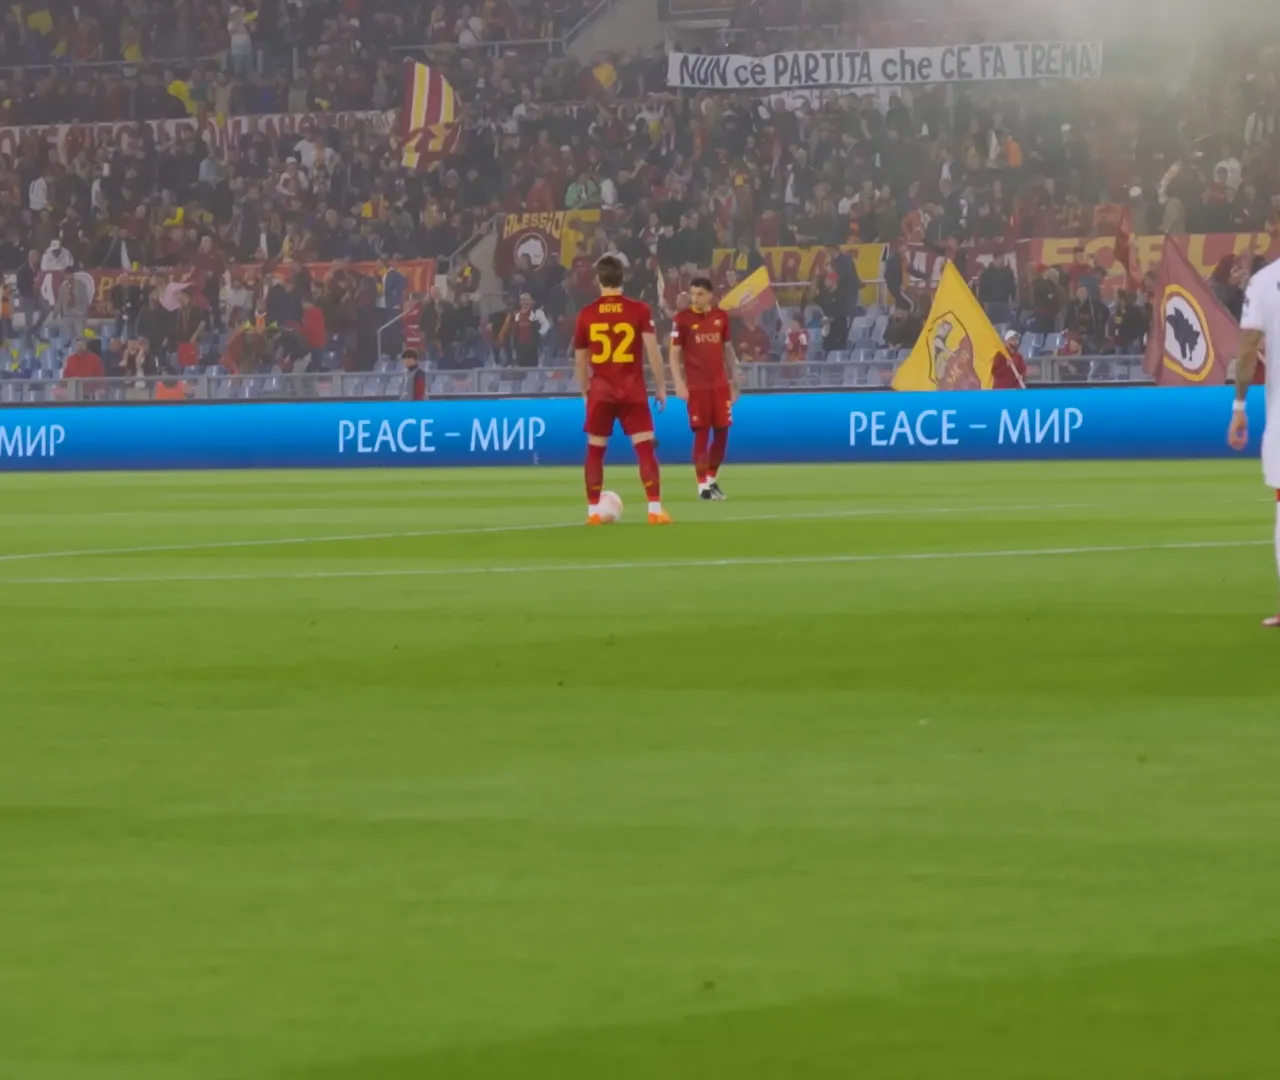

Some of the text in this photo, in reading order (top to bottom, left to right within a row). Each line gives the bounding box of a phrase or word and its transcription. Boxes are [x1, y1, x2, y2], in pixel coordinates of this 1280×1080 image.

[679, 54, 730, 87] NUN
[773, 51, 873, 85] PARTITA
[881, 48, 933, 82] che
[940, 46, 974, 80] CE
[979, 45, 1007, 78] FA
[598, 302, 623, 314] BOVE
[589, 322, 636, 364] 52
[338, 418, 437, 453] PEACE
[469, 415, 547, 452] МИР
[849, 409, 960, 447] PEACE
[997, 407, 1084, 445] МИР
